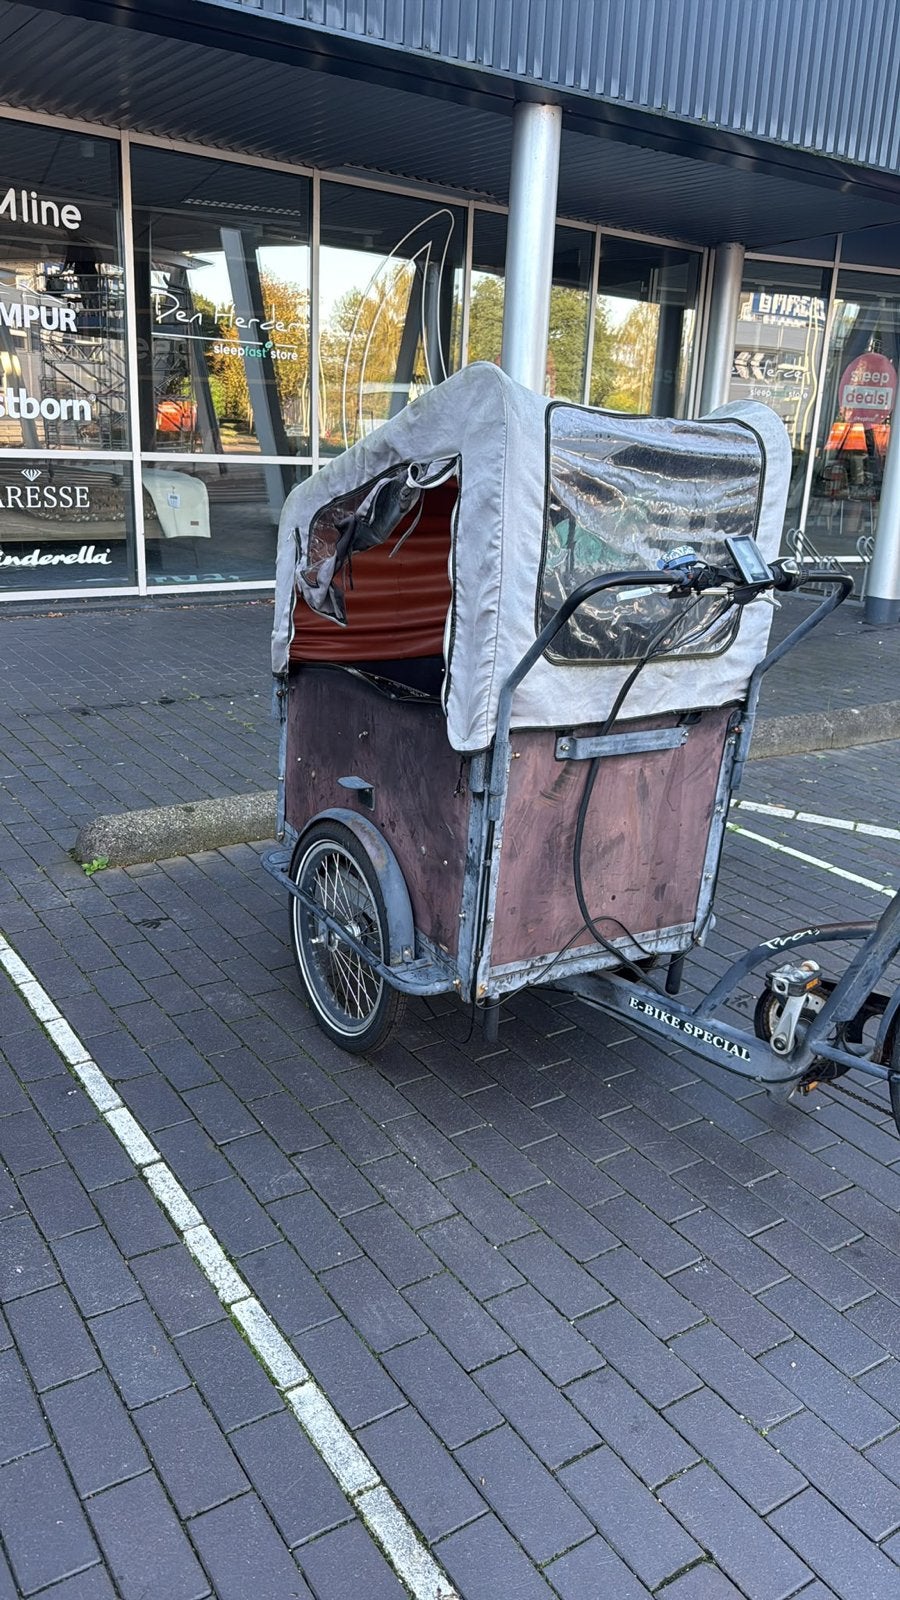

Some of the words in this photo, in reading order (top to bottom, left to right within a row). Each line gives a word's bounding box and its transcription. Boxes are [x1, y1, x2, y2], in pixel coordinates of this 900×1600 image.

[149, 292, 202, 324] Den
[213, 343, 267, 359] sleepfast
[270, 349, 298, 361] store
[851, 371, 890, 386] sleep
[845, 389, 889, 406] deals!
[0, 485, 90, 508] RESSE
[629, 996, 681, 1029] E-BIKE
[683, 1022, 751, 1062] SPECIAL
